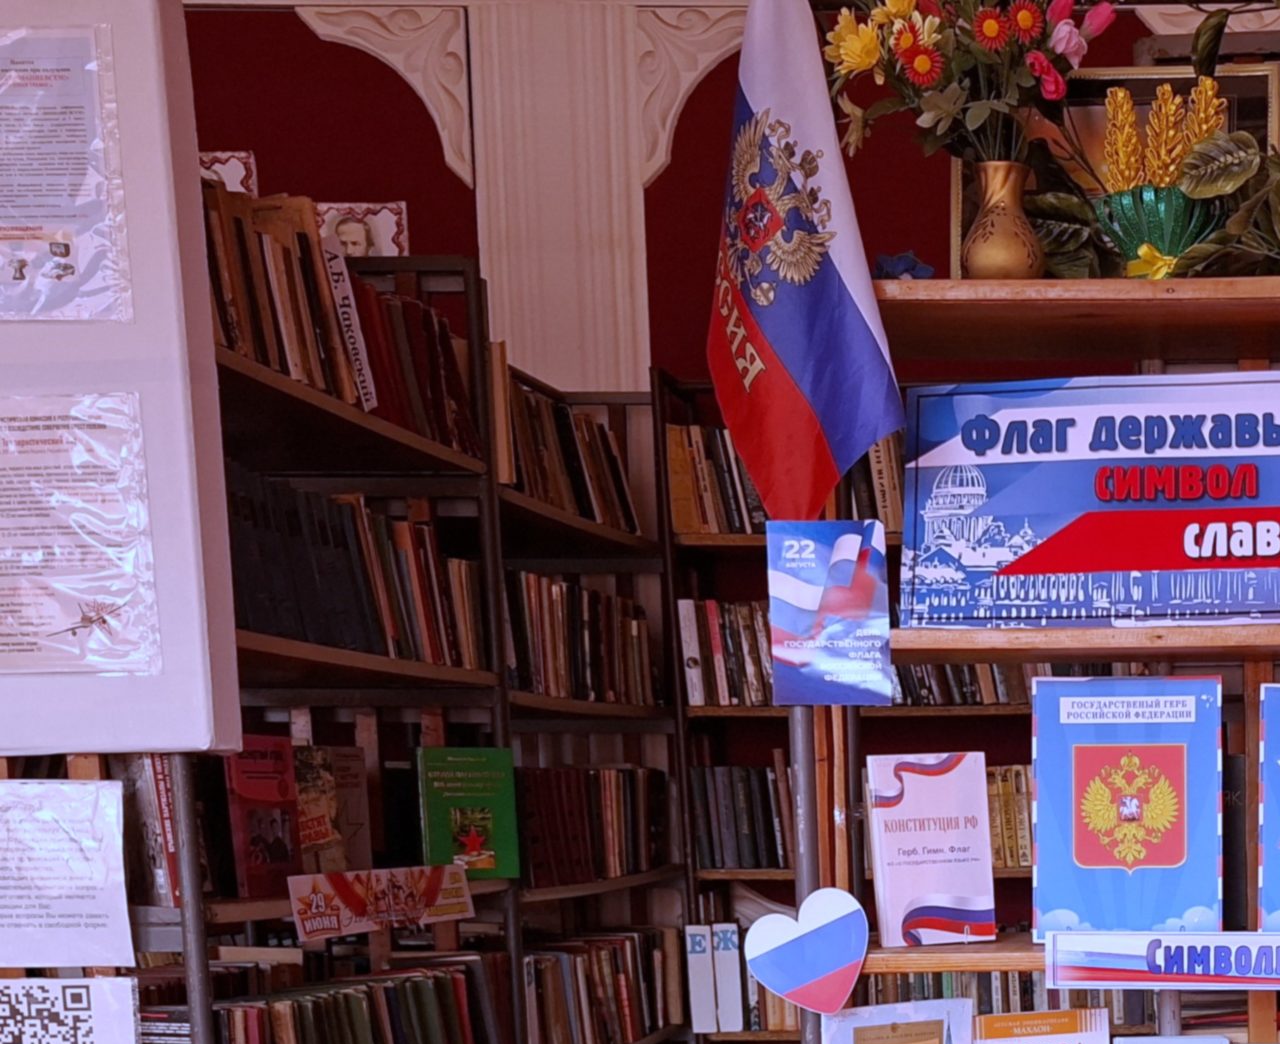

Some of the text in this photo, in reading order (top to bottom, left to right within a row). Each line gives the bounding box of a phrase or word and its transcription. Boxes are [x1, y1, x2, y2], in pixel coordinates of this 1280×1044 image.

[339, 295, 375, 403] Чаковский
[961, 414, 1076, 456] Флаг
[784, 540, 816, 559] 22
[848, 651, 882, 659] ФЛАГА
[1163, 698, 1188, 709] ГЕРБ
[1066, 709, 1192, 720] РОССИЙСКОЙ ФЕДЕРАЦИИ
[884, 815, 979, 833] КОНСТИТУЦИЯ РФ
[948, 845, 971, 855] Флаг
[309, 892, 325, 912] 29
[305, 915, 339, 934] ИЮНЯ
[688, 934, 707, 954] Е
